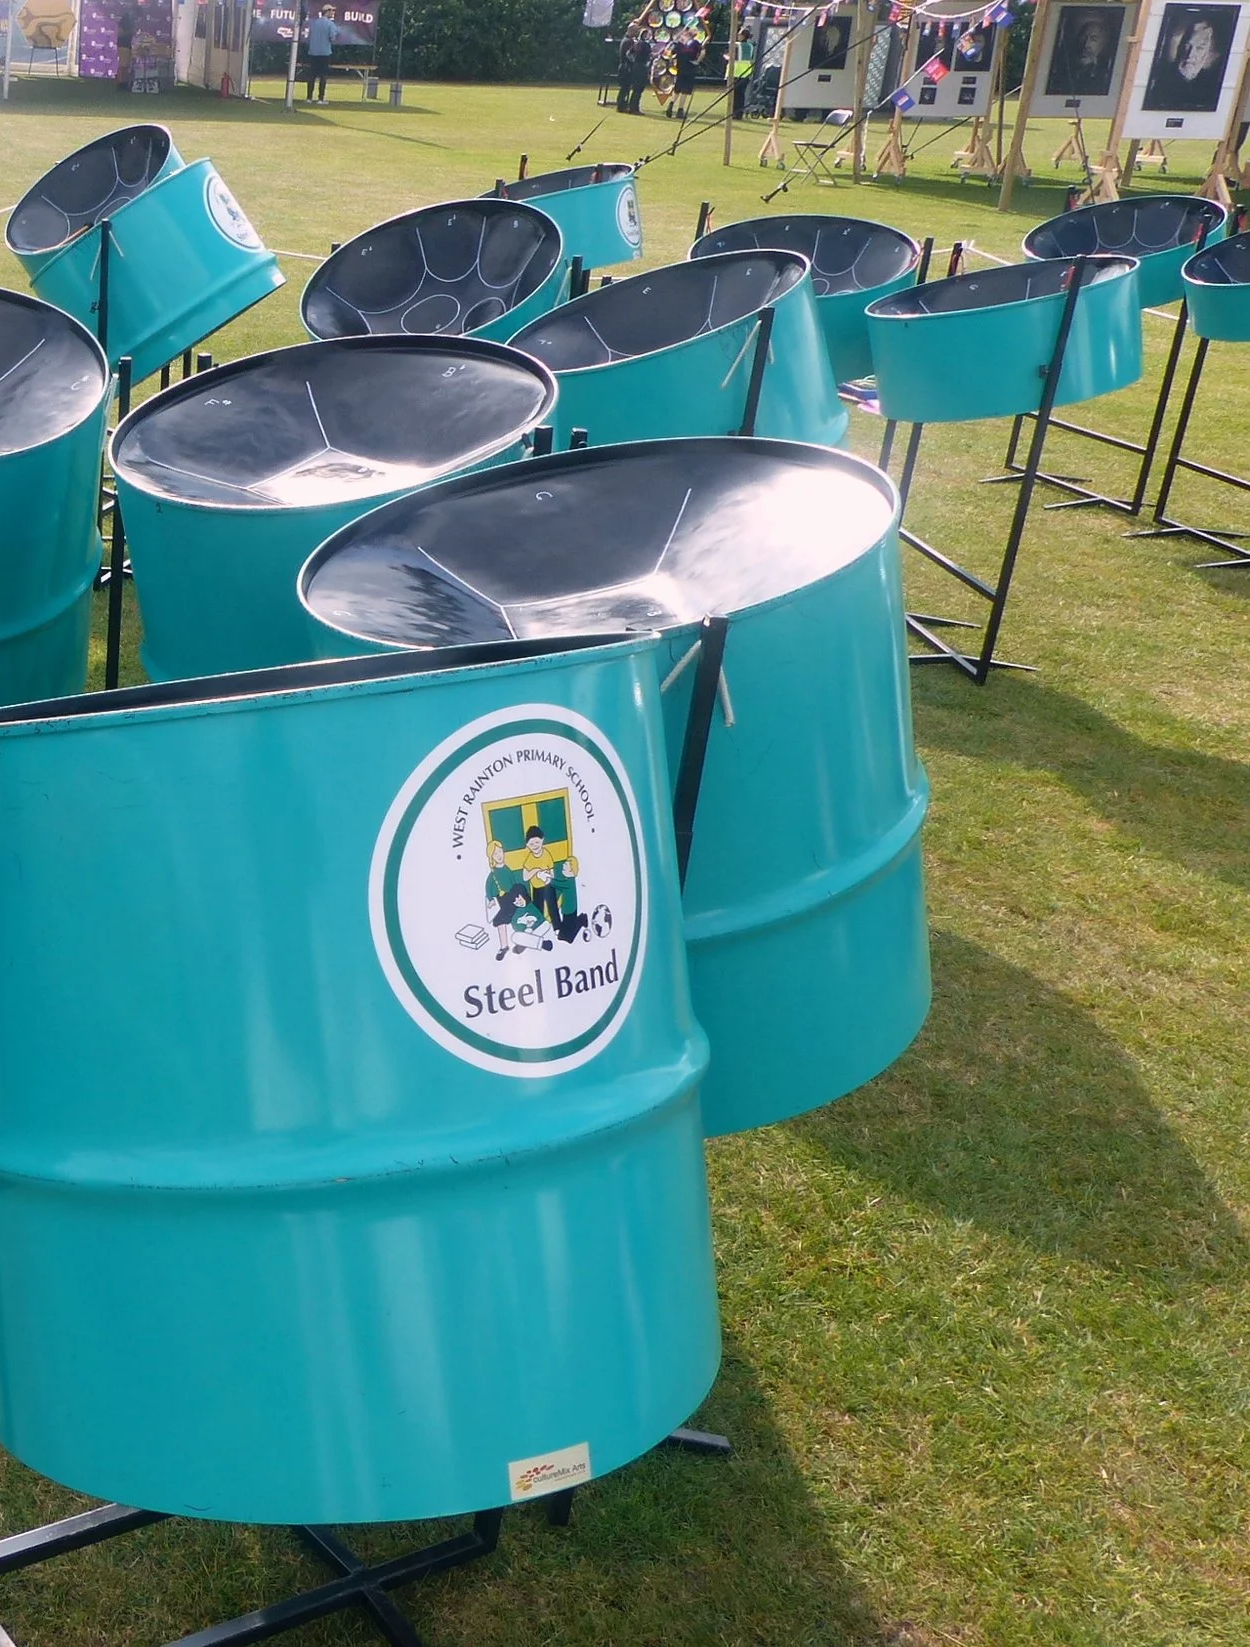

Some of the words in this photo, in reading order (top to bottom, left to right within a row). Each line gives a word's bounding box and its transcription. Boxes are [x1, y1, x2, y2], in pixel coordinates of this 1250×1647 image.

[270, 9, 296, 19] FUTU
[344, 11, 374, 23] BUILD
[452, 806, 469, 849] WEST
[463, 754, 514, 806] RAINTON
[516, 749, 567, 771] PRIMARY
[566, 766, 595, 822] SCHOOL
[463, 968, 544, 1018] Steel
[555, 948, 619, 999] Band
[572, 1462, 586, 1473] Arts
